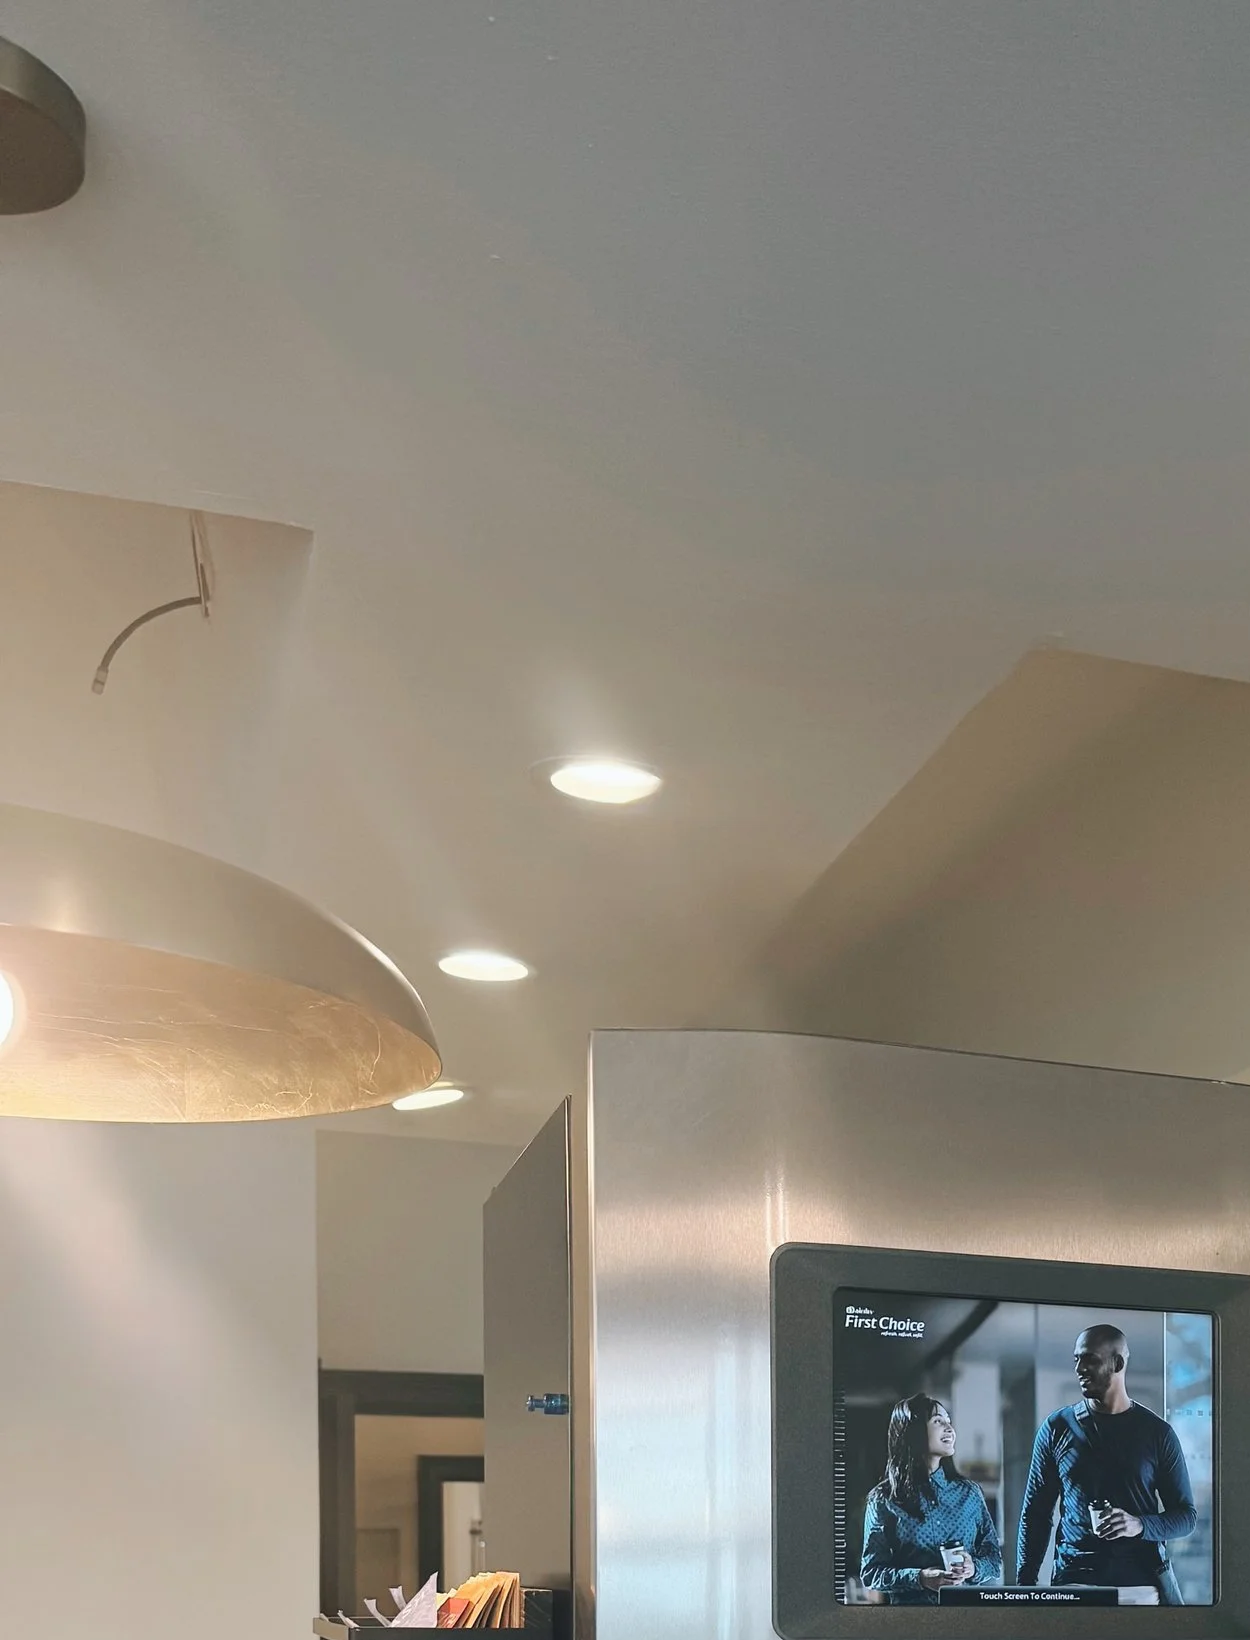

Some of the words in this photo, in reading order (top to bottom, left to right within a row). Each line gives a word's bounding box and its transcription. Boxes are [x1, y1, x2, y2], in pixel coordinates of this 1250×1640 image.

[845, 1314, 877, 1329] First
[878, 1316, 925, 1332] Choice
[980, 1592, 1003, 1600] Touch
[1004, 1592, 1029, 1600] Screen
[1030, 1592, 1040, 1600] To
